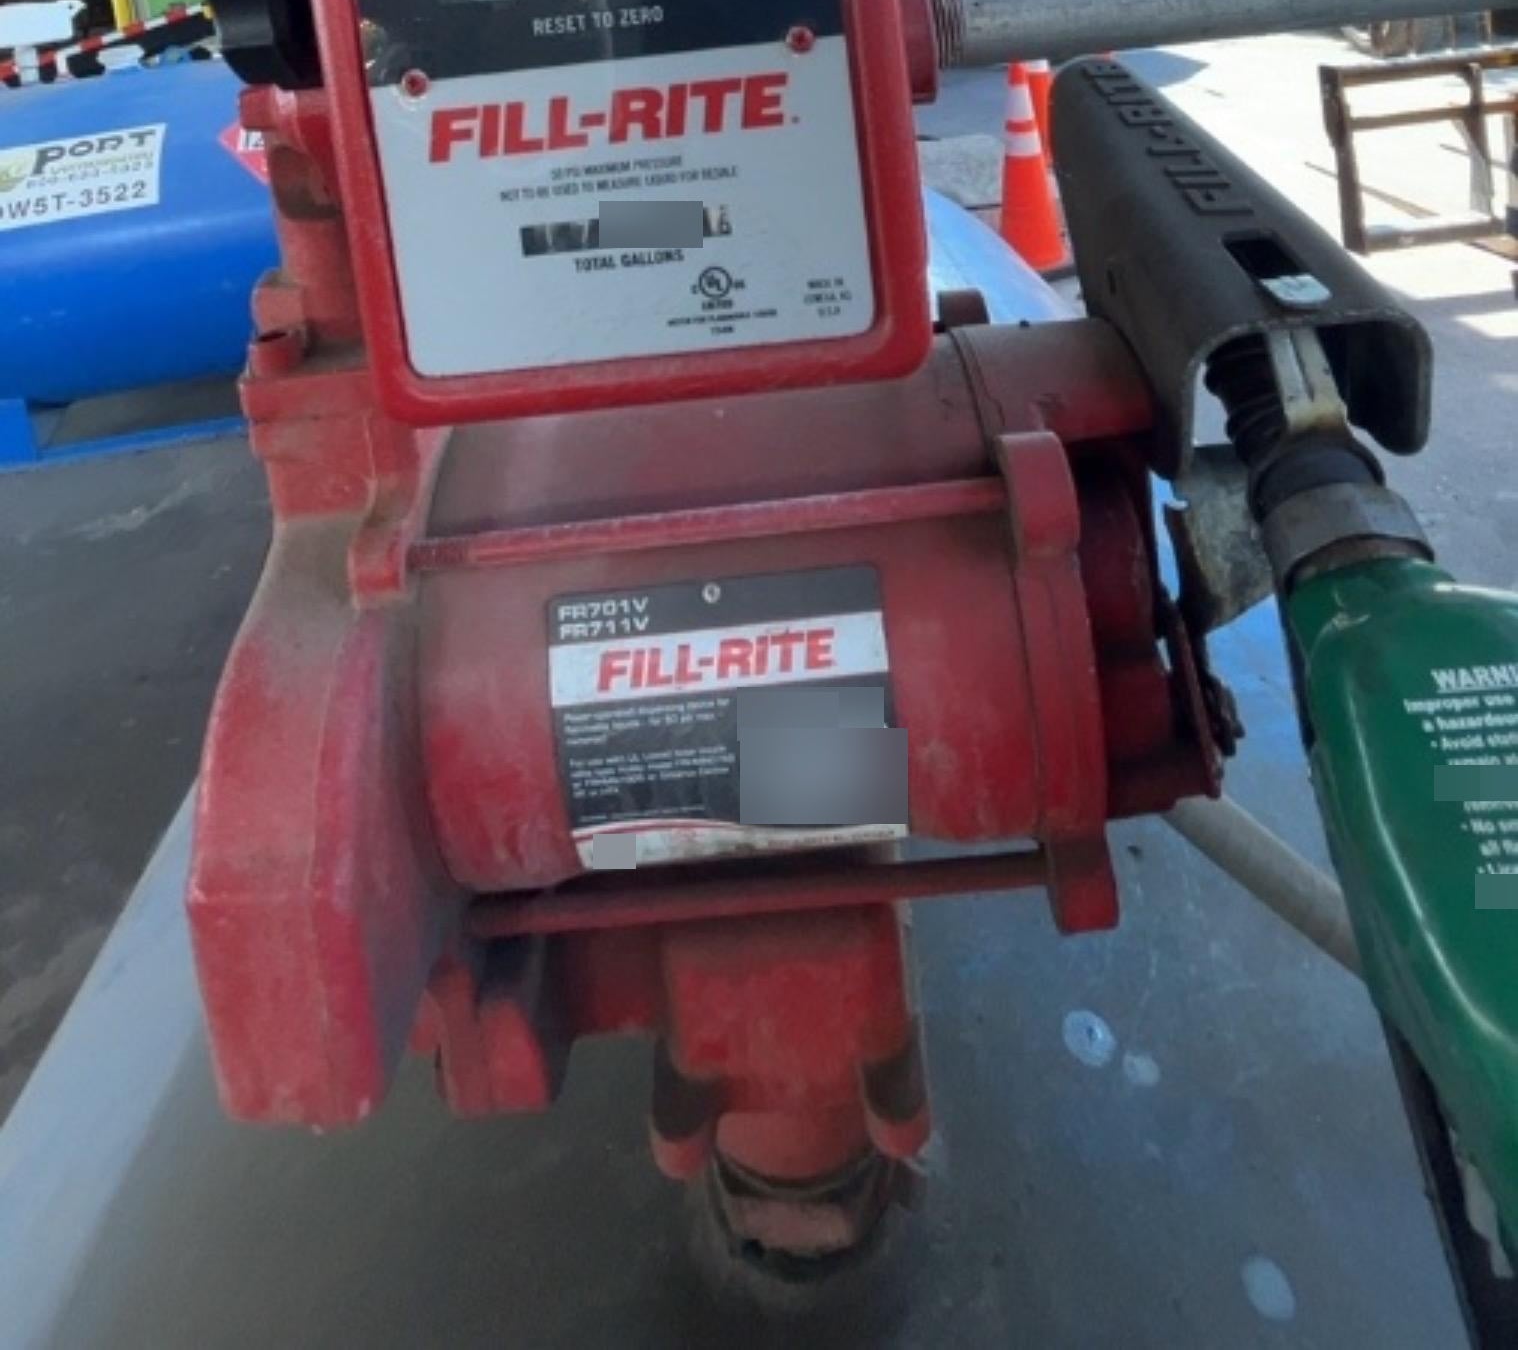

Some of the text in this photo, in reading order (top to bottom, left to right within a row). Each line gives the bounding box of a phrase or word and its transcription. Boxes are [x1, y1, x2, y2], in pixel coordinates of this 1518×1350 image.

[533, 5, 664, 37] RESET TO ZERO
[584, 161, 631, 177] MAXIMUM
[633, 155, 682, 172] PRESSURE
[500, 189, 520, 202] NOT
[521, 187, 534, 200] TO
[551, 182, 579, 196] USED
[582, 180, 595, 194] TO
[597, 175, 642, 193] MEASURE
[680, 169, 700, 183] FOR
[702, 165, 739, 180] RESALE
[574, 249, 685, 273] TOTAL GALLONS
[557, 596, 649, 622] FR701V
[559, 616, 650, 641] FR711V
[596, 629, 835, 694] FILL-RITE
[1403, 694, 1516, 715] Improper use
